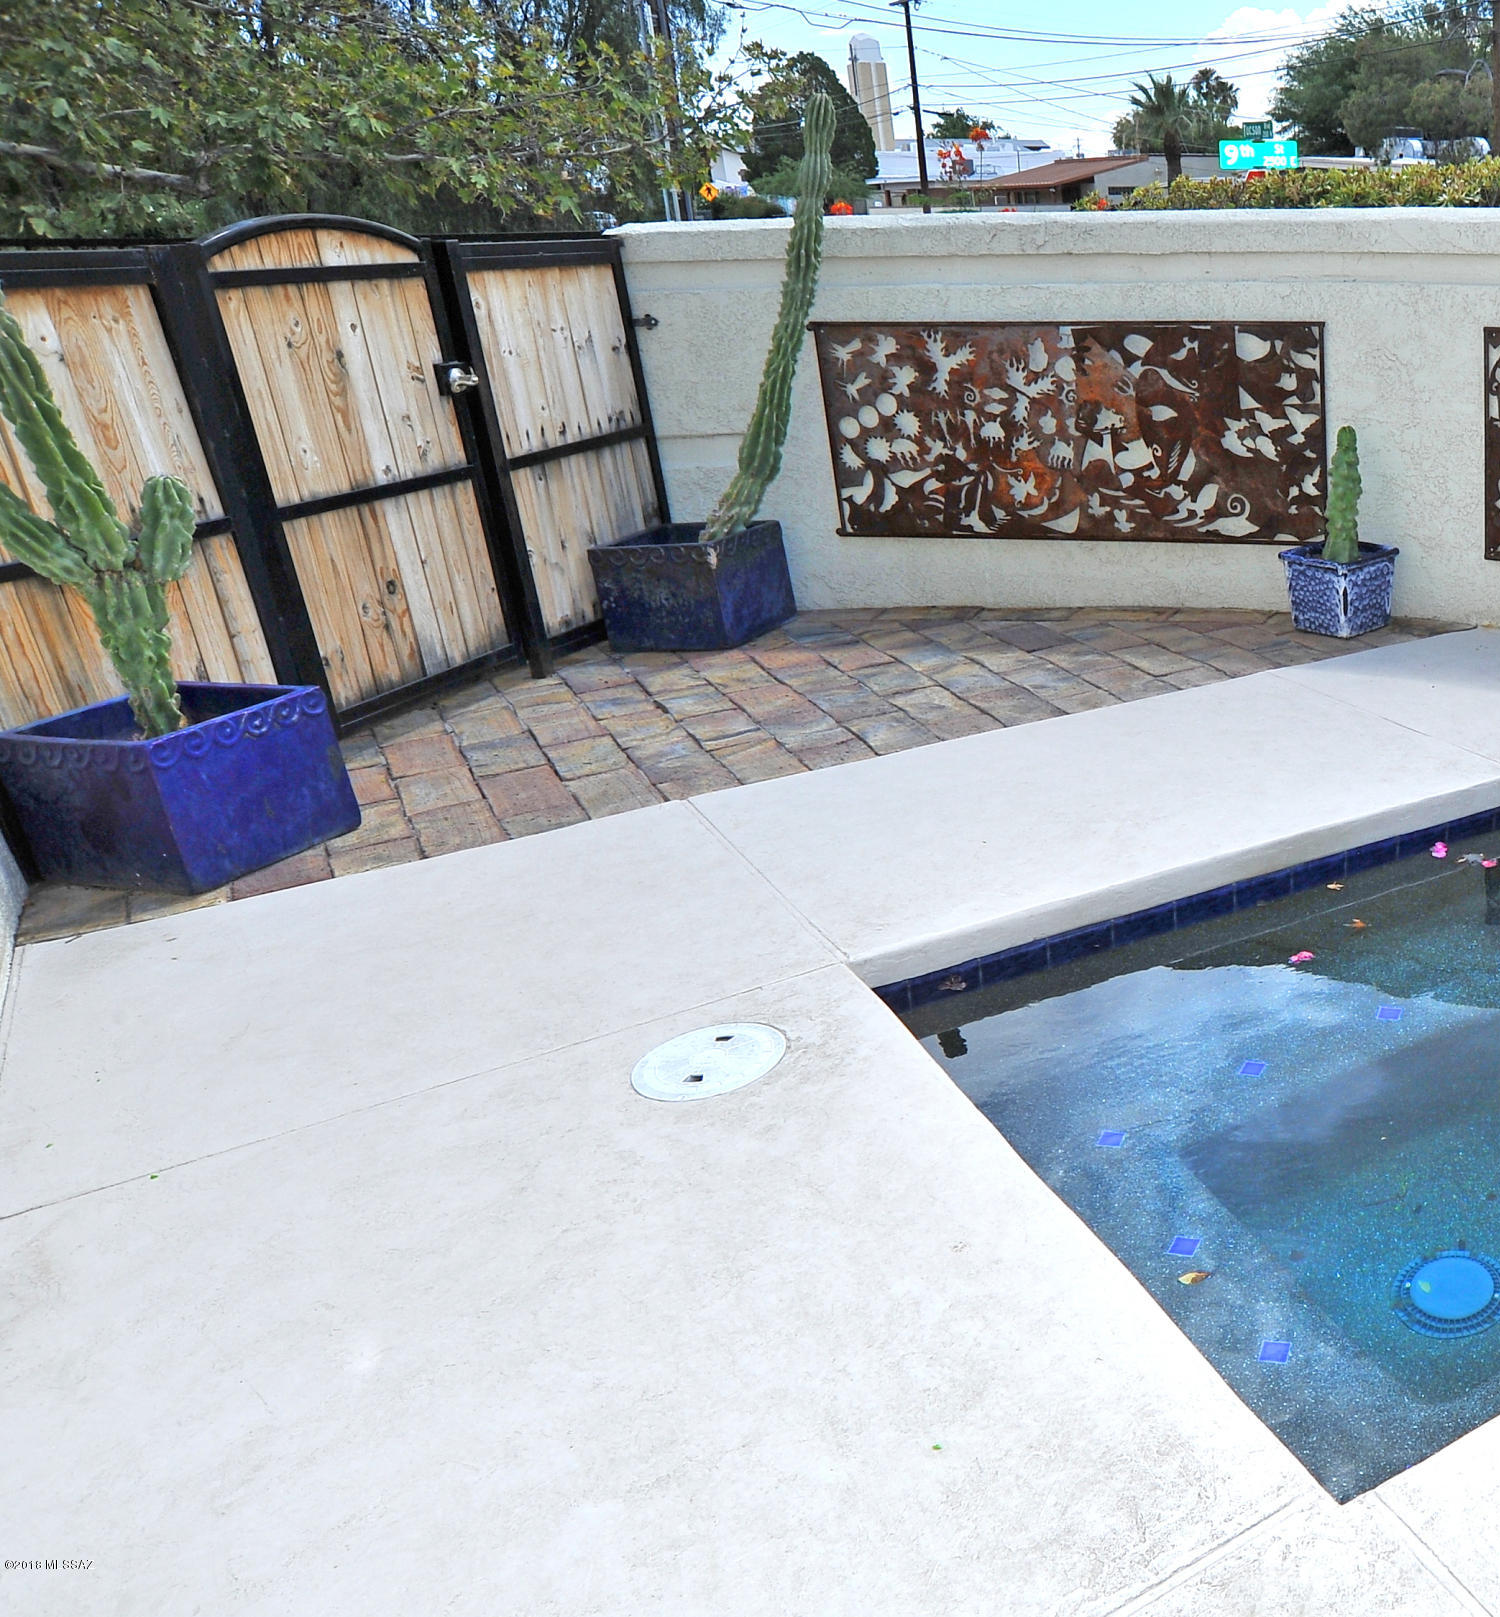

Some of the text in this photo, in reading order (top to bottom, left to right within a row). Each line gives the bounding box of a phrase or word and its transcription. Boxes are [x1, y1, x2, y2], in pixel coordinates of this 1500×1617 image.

[1224, 143, 1284, 165] 9th St
[1263, 155, 1287, 167] 2500
